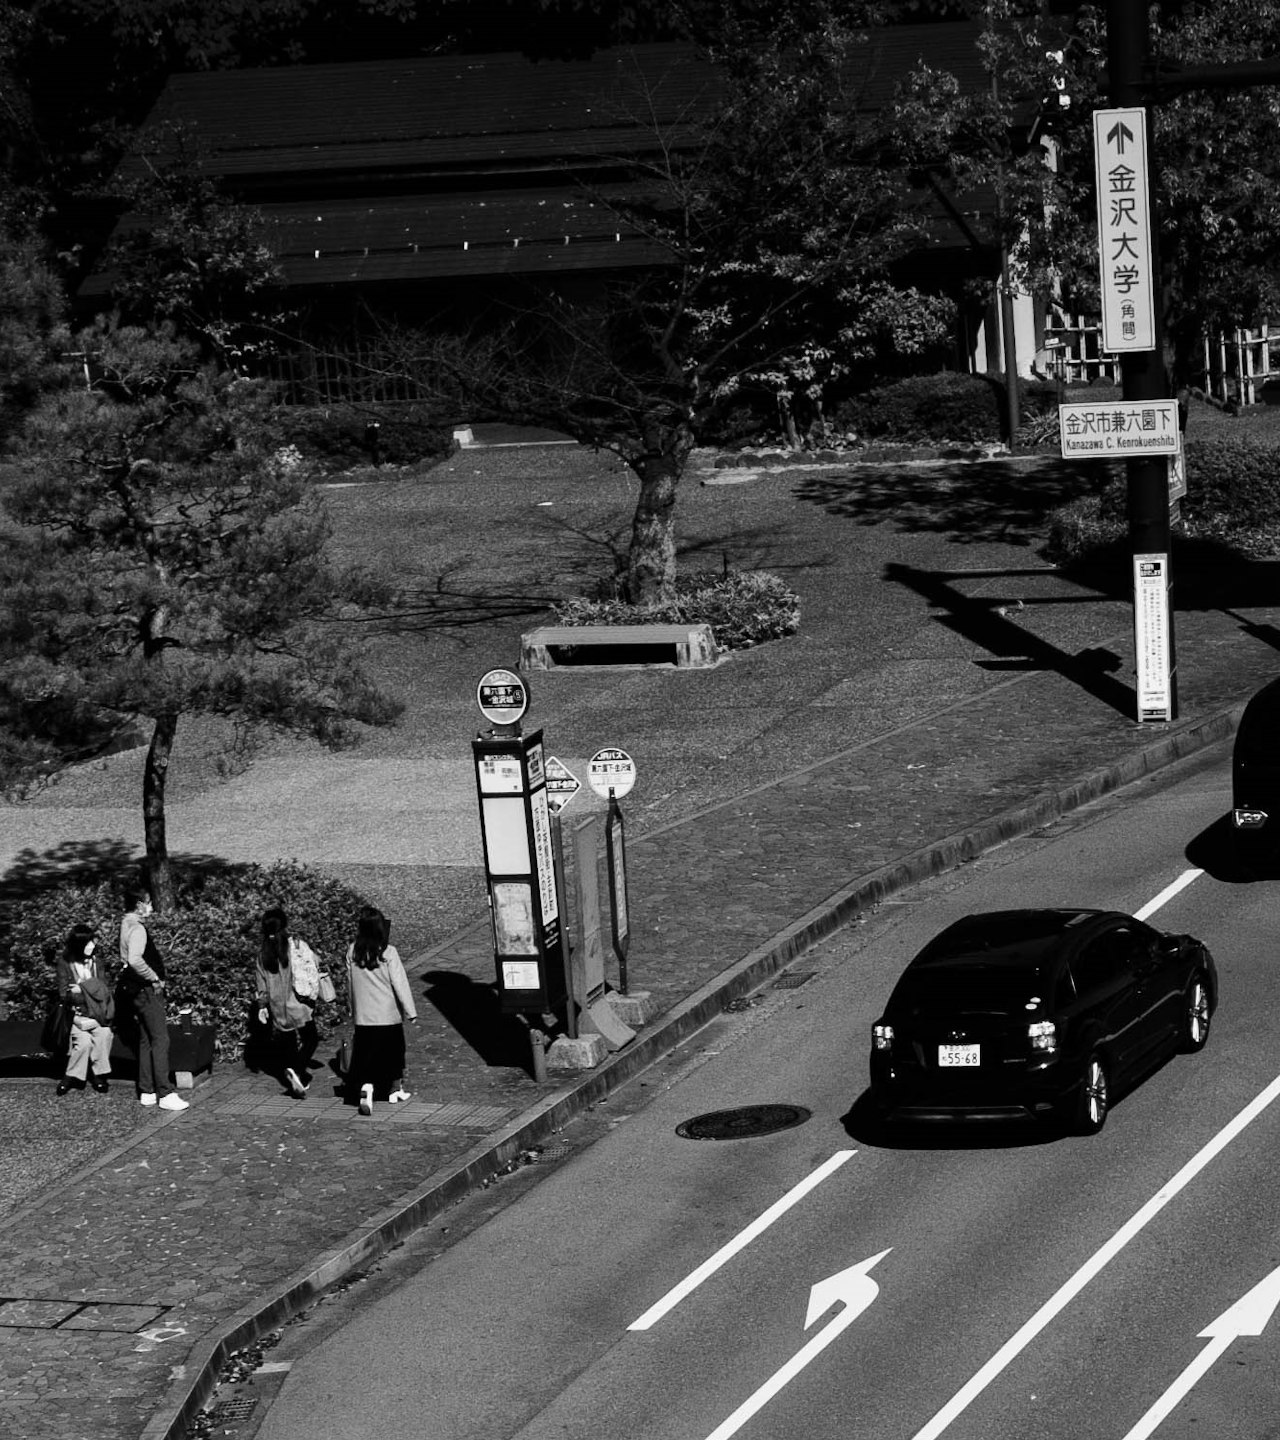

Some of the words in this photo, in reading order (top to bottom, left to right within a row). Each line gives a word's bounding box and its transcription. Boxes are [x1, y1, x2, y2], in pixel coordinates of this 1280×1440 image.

[1065, 408, 1171, 435] 金沢市兼六園下
[1066, 439, 1104, 450] Kanazawa
[1117, 434, 1175, 448] Kenrokuenshita
[947, 1052, 978, 1065] 55-68
